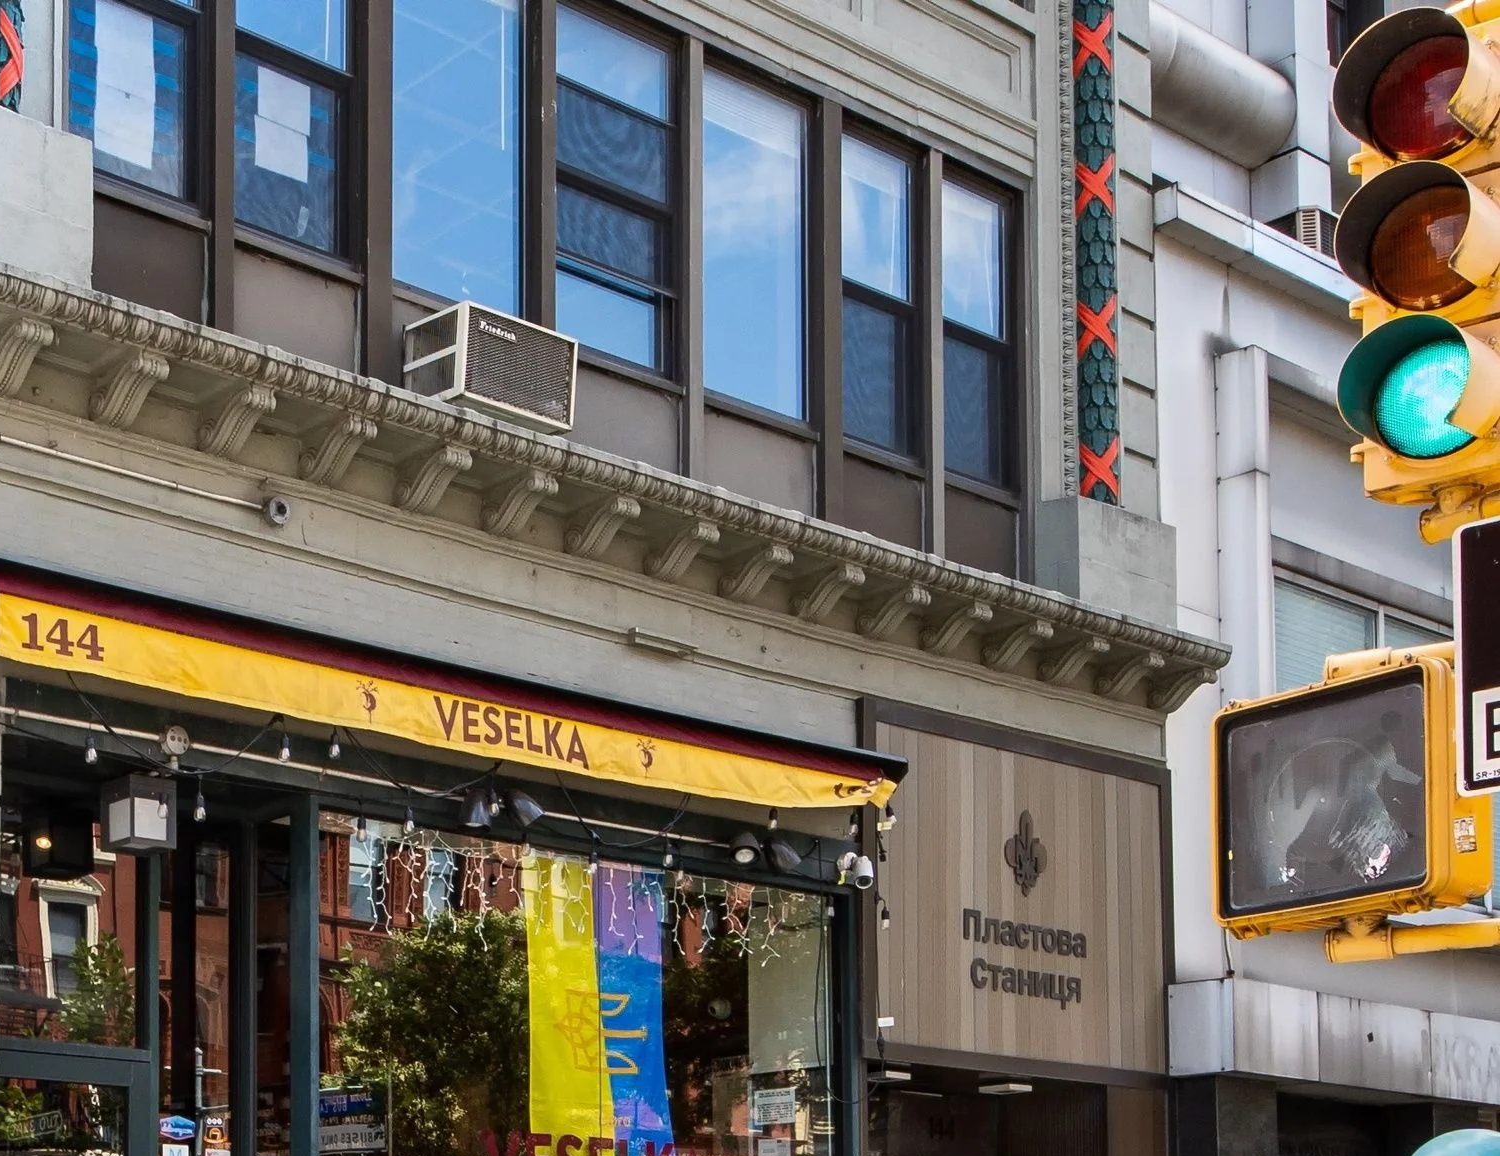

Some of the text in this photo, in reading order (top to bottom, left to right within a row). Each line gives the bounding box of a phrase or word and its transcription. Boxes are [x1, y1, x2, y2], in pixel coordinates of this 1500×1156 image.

[478, 320, 517, 342] Friedrich
[22, 613, 105, 662] 144
[433, 695, 590, 771] VESELKA
[963, 908, 1087, 958] Пластова
[970, 958, 1081, 1010] Станиця
[928, 1115, 955, 1141] 144
